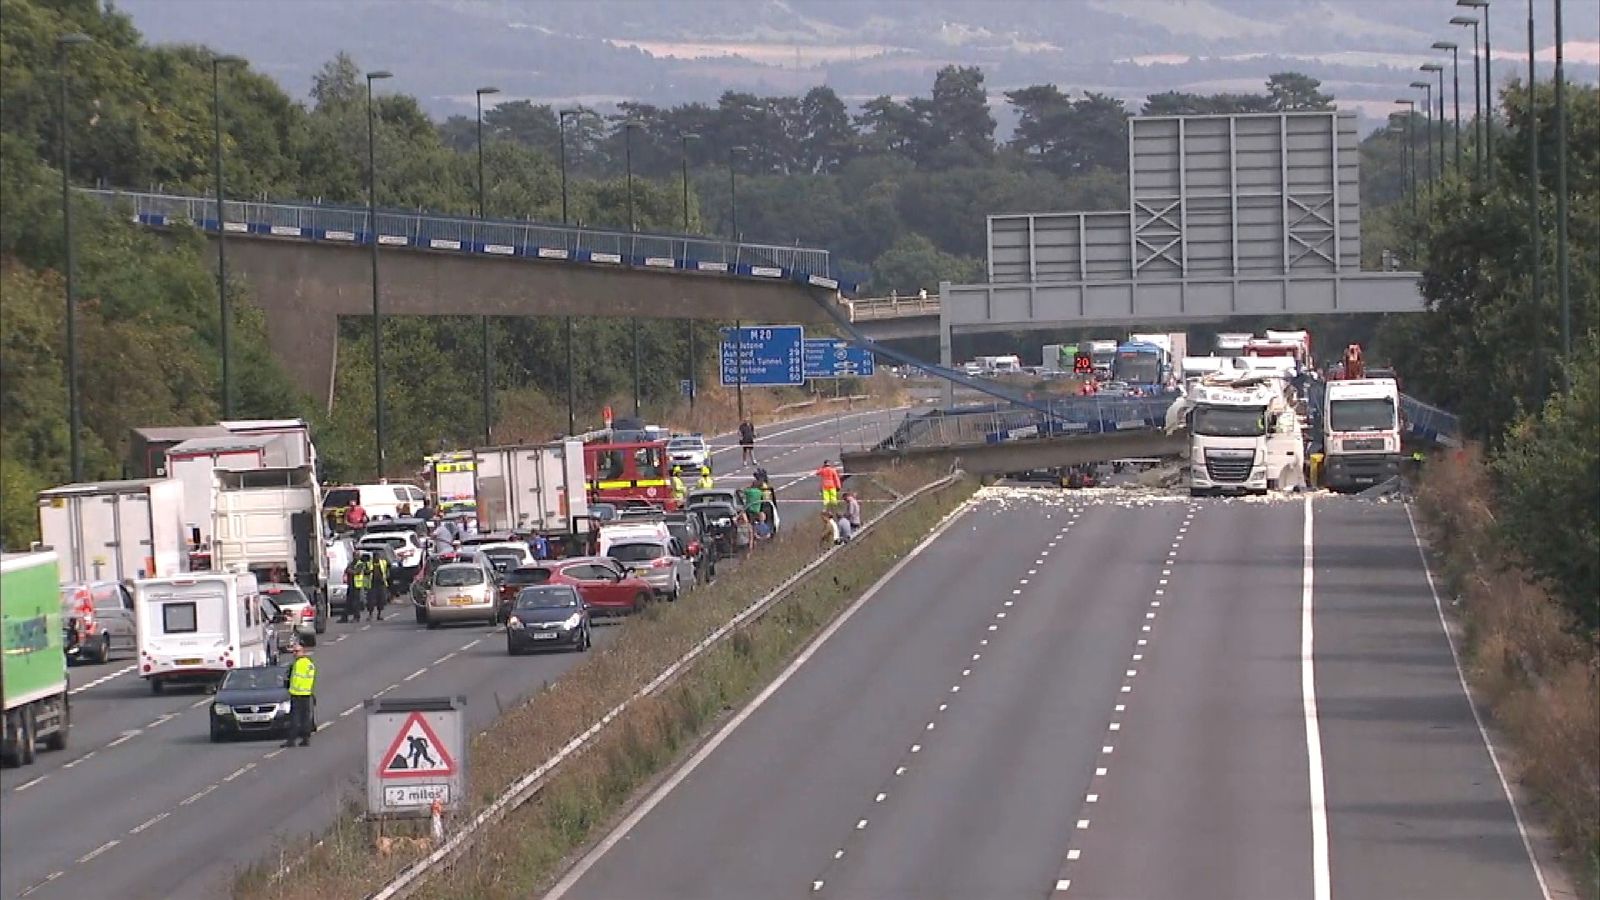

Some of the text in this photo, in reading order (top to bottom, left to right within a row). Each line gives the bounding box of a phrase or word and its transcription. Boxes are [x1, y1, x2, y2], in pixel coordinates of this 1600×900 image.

[750, 329, 772, 340] M20
[723, 349, 754, 357] Ashord
[723, 358, 755, 366] Chanel
[757, 357, 783, 366] Tunnel
[1076, 357, 1089, 367] 20
[396, 788, 441, 801] 2 miles
